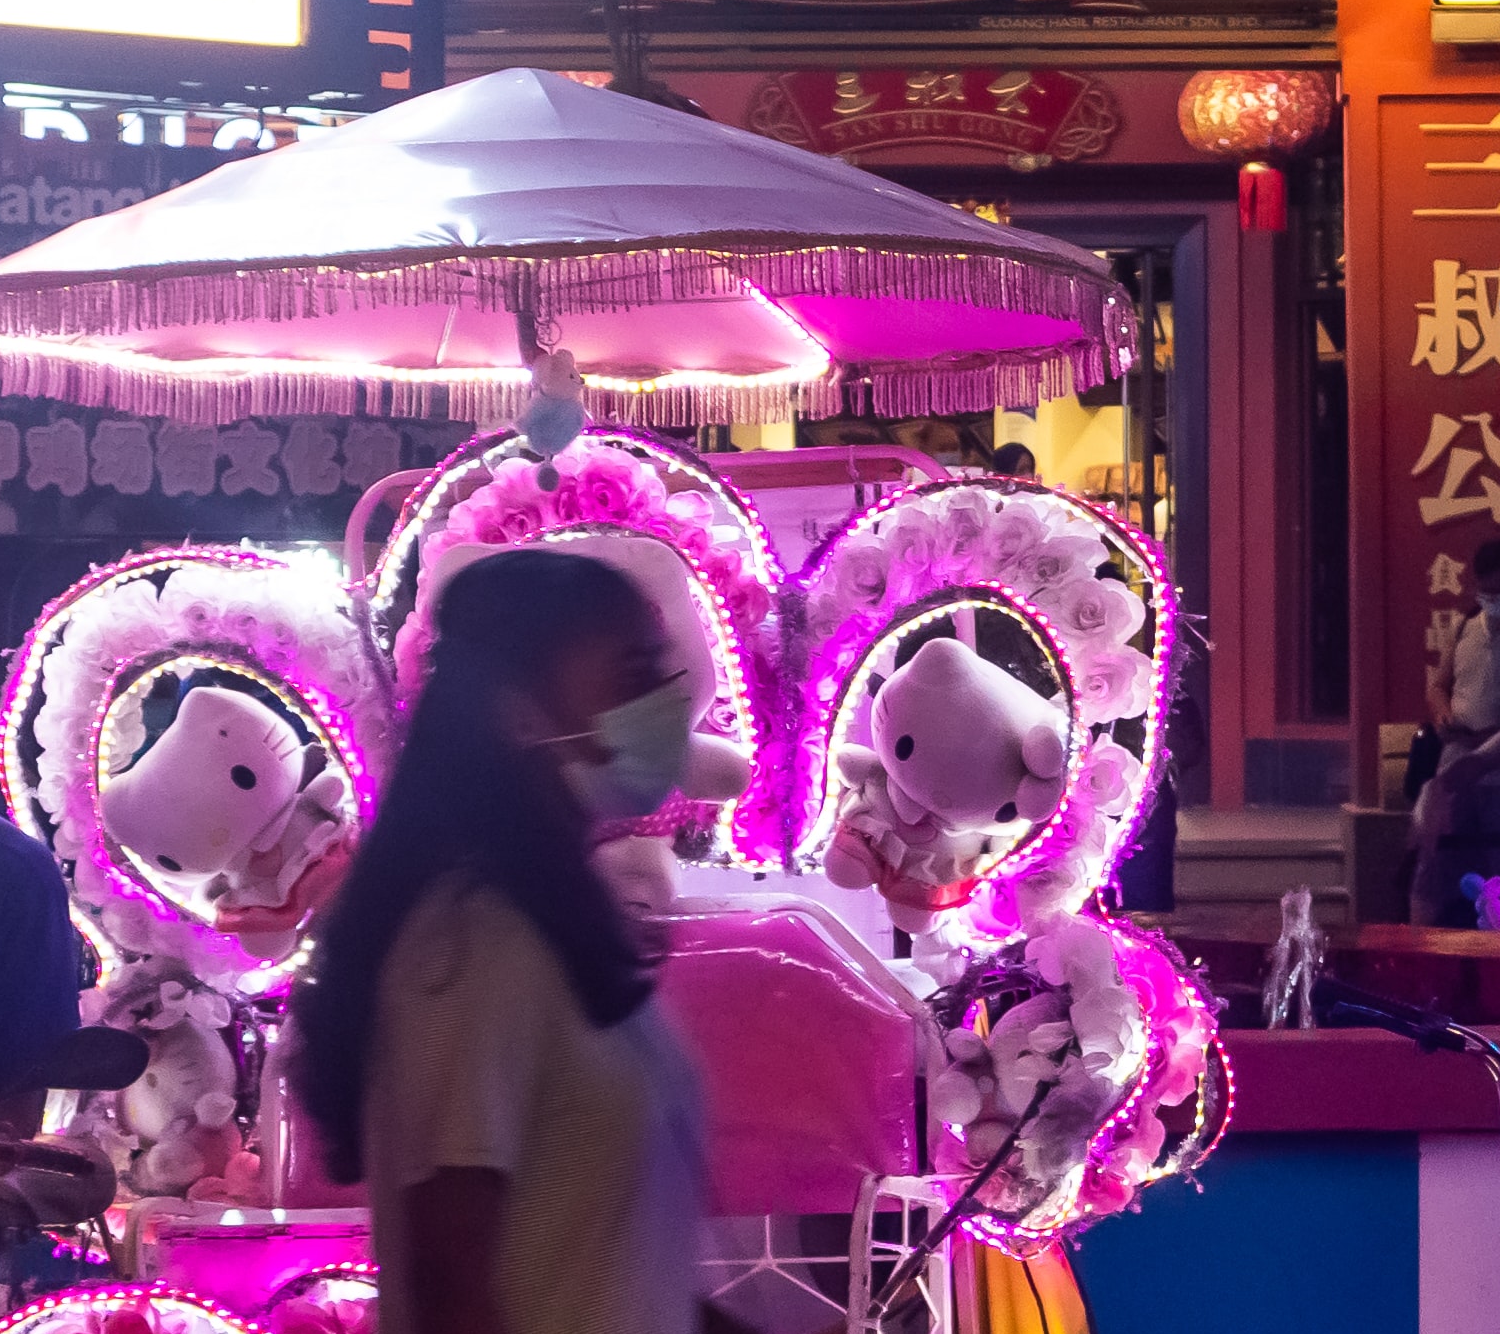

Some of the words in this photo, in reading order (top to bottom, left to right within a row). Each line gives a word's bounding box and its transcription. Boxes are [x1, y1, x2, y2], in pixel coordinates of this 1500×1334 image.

[979, 15, 1047, 31] GUDANG
[1049, 15, 1089, 30] HASIL
[1091, 15, 1187, 30] RESTAURANT
[893, 113, 946, 135] SHU
